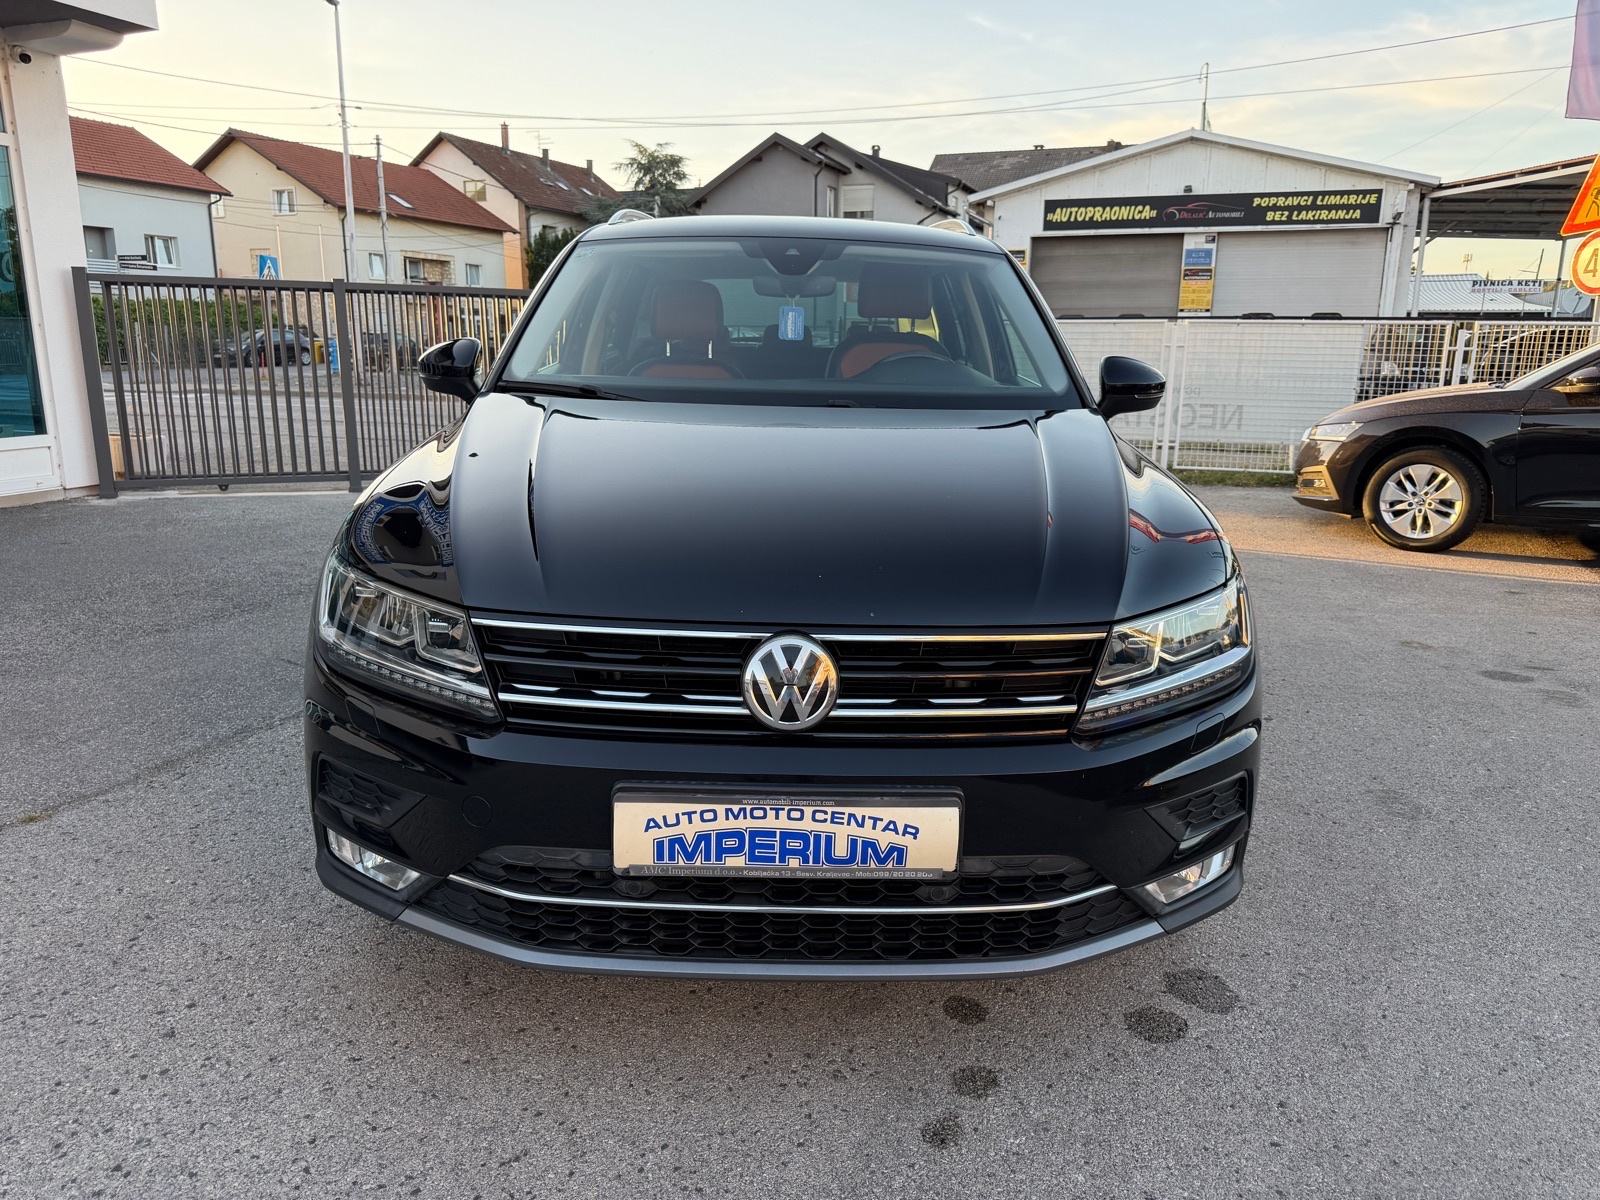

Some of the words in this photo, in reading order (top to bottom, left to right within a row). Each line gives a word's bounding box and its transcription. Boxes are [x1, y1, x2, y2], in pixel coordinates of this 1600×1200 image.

[1252, 196, 1314, 207] POPRAVCI
[1316, 194, 1378, 205] LIMARIJE
[1265, 211, 1289, 221] BEZ
[1292, 209, 1361, 220] LAKIRANJA
[1471, 279, 1514, 287] PIVNICA
[1517, 279, 1542, 287] KETI
[644, 808, 718, 832] AUTO
[725, 806, 805, 822] MOTO
[811, 809, 920, 840] CENTAR
[653, 827, 908, 867] IMPERIUM
[668, 867, 713, 877] Imperium
[816, 871, 851, 879] Kraljevec
